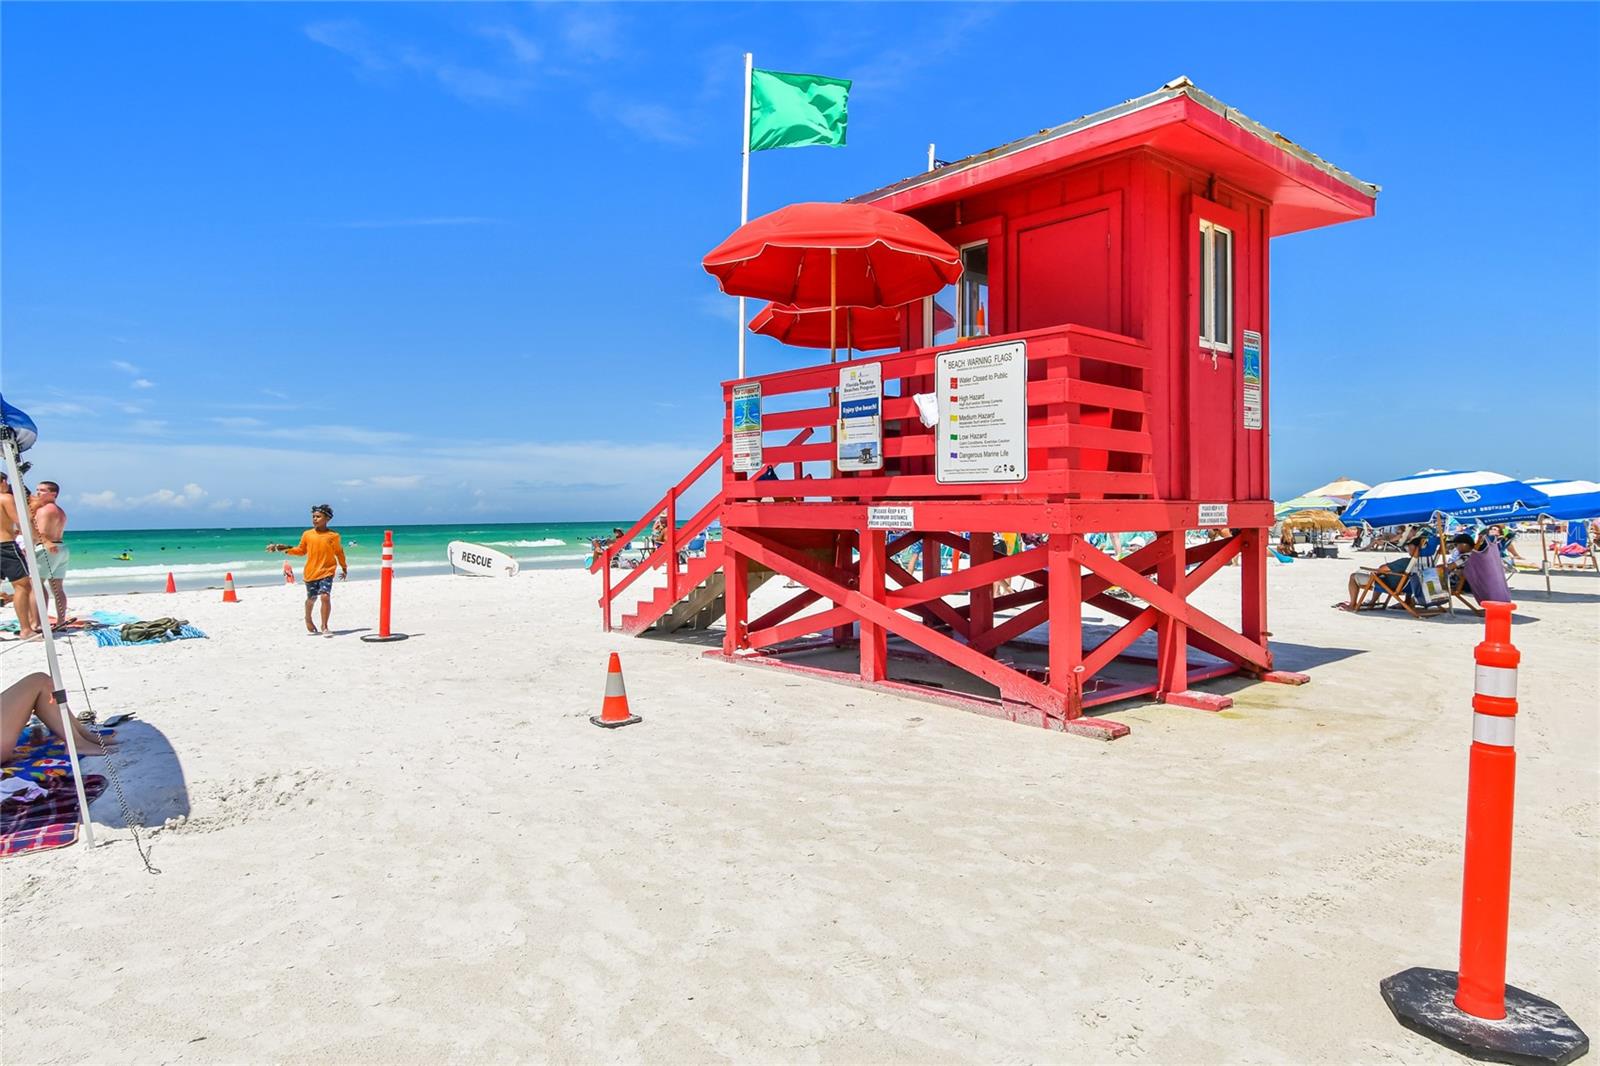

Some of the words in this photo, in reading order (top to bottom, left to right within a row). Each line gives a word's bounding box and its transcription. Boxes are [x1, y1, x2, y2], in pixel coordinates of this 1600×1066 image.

[948, 360, 965, 369] BEACH
[967, 355, 992, 366] WARNING
[994, 353, 1013, 363] FLAGS
[972, 374, 987, 382] Closed
[994, 372, 1008, 380] Public
[862, 403, 877, 411] beach!
[969, 432, 987, 440] Hazard
[1000, 449, 1009, 457] Life
[461, 551, 493, 568] RESCUE
